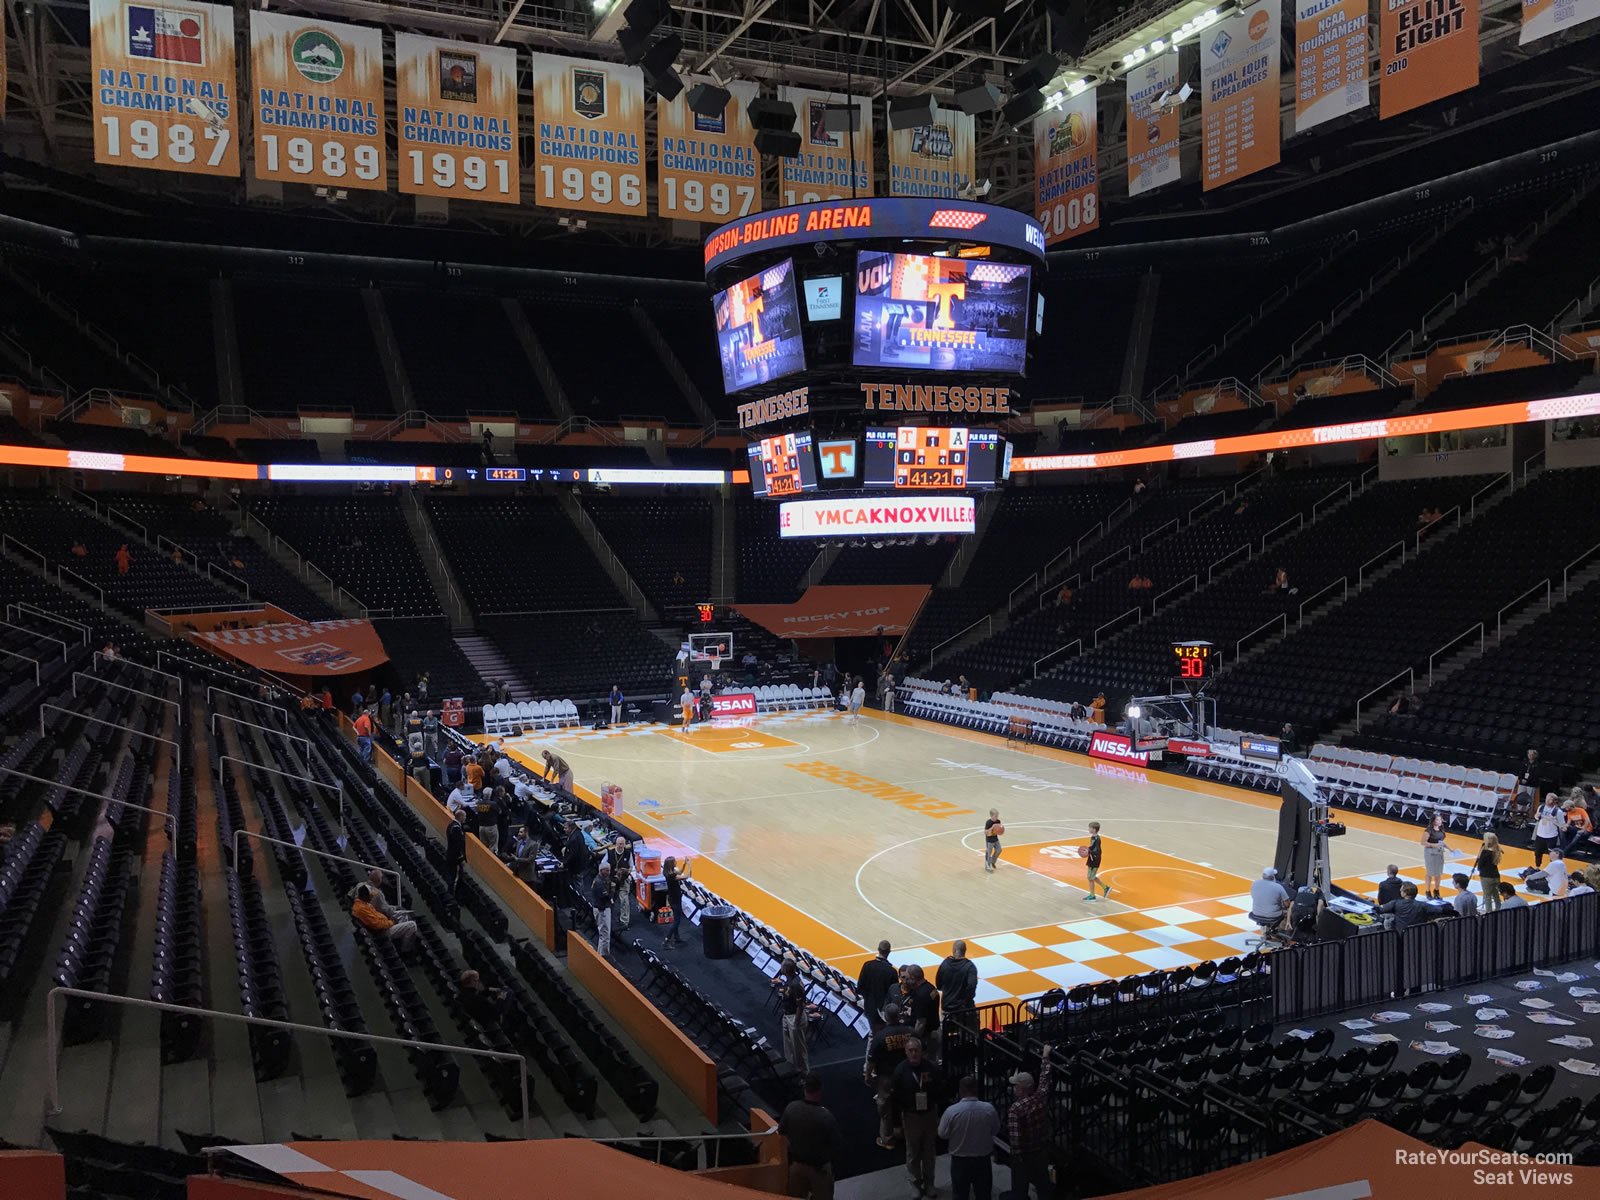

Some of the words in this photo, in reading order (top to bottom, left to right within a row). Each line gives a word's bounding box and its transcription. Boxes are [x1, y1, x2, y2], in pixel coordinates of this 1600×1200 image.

[1318, 10, 1345, 33] NCAA
[1395, 8, 1466, 55] EIGHT
[1299, 14, 1367, 53] TOURNAMENT
[1387, 58, 1408, 75] 2010
[100, 69, 229, 100] NATIONAL
[1130, 76, 1175, 102] VOLLEYBALL
[1211, 70, 1268, 103] APPEARANCES
[1212, 70, 1238, 91] FINAL
[260, 89, 378, 118] NATIONAL
[260, 107, 378, 136] CHAMPIONS
[404, 107, 512, 134] NATIONAL
[102, 116, 230, 166] 1987
[404, 125, 512, 151] CHAMPIONS
[540, 122, 639, 149] NATIONAL
[262, 134, 380, 180] 1989
[540, 140, 640, 165] CHAMPIONS
[663, 137, 755, 162] NATIONAL
[408, 150, 510, 193] 1991
[663, 154, 755, 178] CHAMPIONS
[784, 153, 868, 174] NATIONAL
[1039, 154, 1095, 189] NATIONAL
[540, 165, 641, 206] 1996
[784, 167, 868, 189] CHAMPIONS
[892, 164, 969, 186] NATIONAL
[664, 177, 755, 217] 1997
[1039, 170, 1096, 205] CHAMPIONS
[1415, 189, 1430, 200] 318
[805, 205, 872, 232] ARENA
[1040, 192, 1096, 238] 2008
[288, 256, 304, 266] 312
[562, 276, 578, 287] 314
[928, 282, 966, 329] T
[910, 328, 977, 345] TENNESSEE
[737, 386, 809, 429] TENNESSEE
[860, 383, 1010, 414] TENNESSEE
[902, 430, 912, 443] T
[953, 432, 963, 445] A
[1313, 420, 1388, 442] TENNESSEE
[930, 438, 935, 447] 1
[822, 445, 852, 474] T
[903, 452, 910, 463] 0
[918, 456, 924, 464] 4
[940, 456, 946, 464] 4
[954, 452, 961, 463] 0
[1024, 454, 1097, 469] TENNESSEE
[419, 468, 431, 479] T
[445, 469, 452, 479] 0
[493, 470, 518, 479] 41:21
[573, 470, 580, 480] 0
[594, 471, 602, 481] A
[898, 477, 904, 485] 0
[911, 471, 950, 486] 41:21
[956, 477, 962, 485] 0
[773, 478, 794, 492] 41:21
[700, 611, 712, 621] 30
[783, 611, 848, 623] ROCKY
[853, 606, 890, 617] TOP
[1175, 647, 1208, 657] 41:21
[1181, 658, 1202, 677] 30
